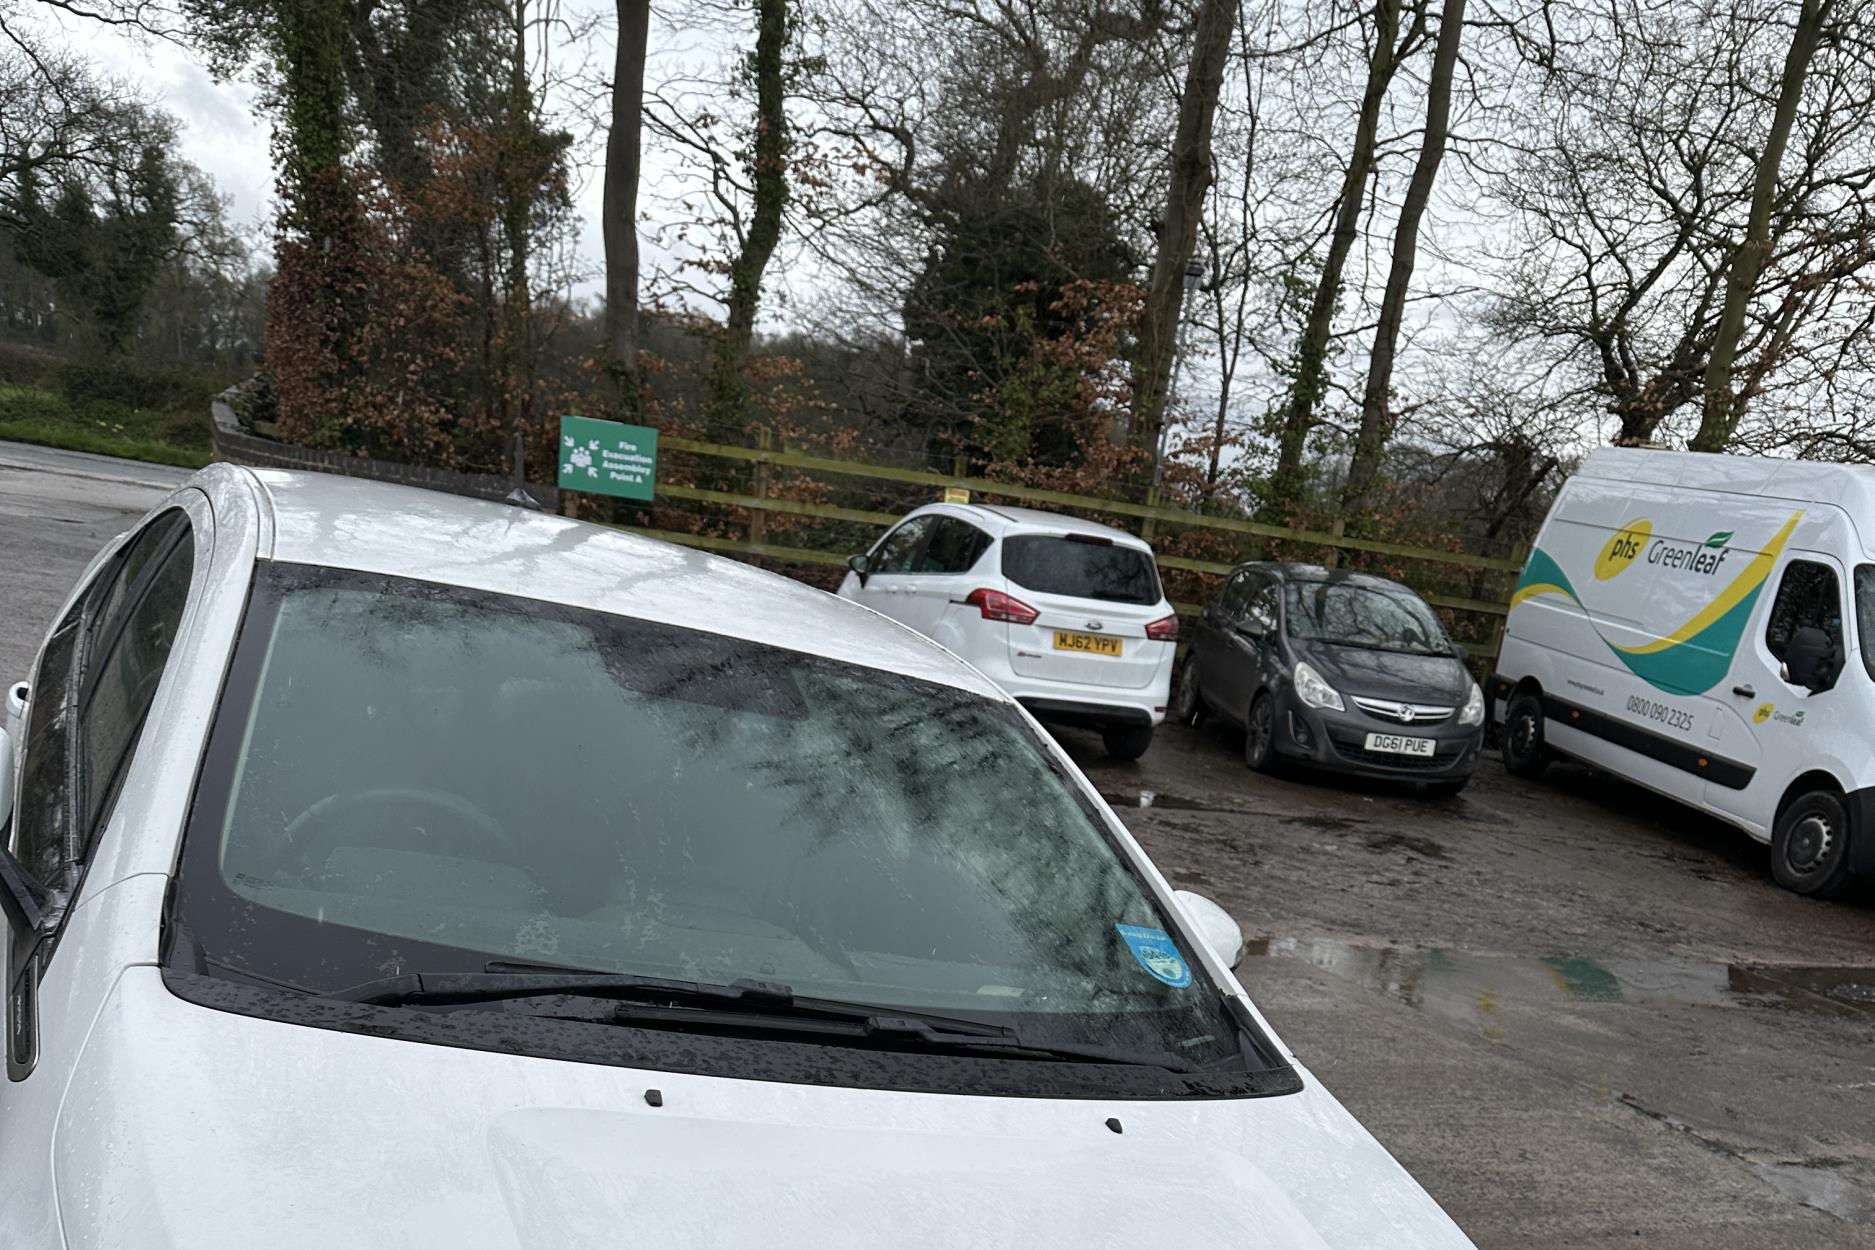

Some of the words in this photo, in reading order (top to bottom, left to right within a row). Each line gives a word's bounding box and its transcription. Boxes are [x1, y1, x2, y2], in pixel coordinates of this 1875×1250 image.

[619, 441, 637, 451] Fire
[602, 449, 653, 463] Evacuation
[609, 471, 634, 482] Point
[635, 475, 643, 483] A
[1608, 532, 1640, 561] phs
[1647, 539, 1731, 576] Greenleaf
[1059, 633, 1091, 650] MJ62
[1094, 637, 1119, 653] YPV
[1626, 694, 1651, 717] 0800
[1649, 702, 1669, 723] 090
[1667, 709, 1695, 732] 2325
[1374, 735, 1403, 750] DG61
[1404, 739, 1429, 753] PUE
